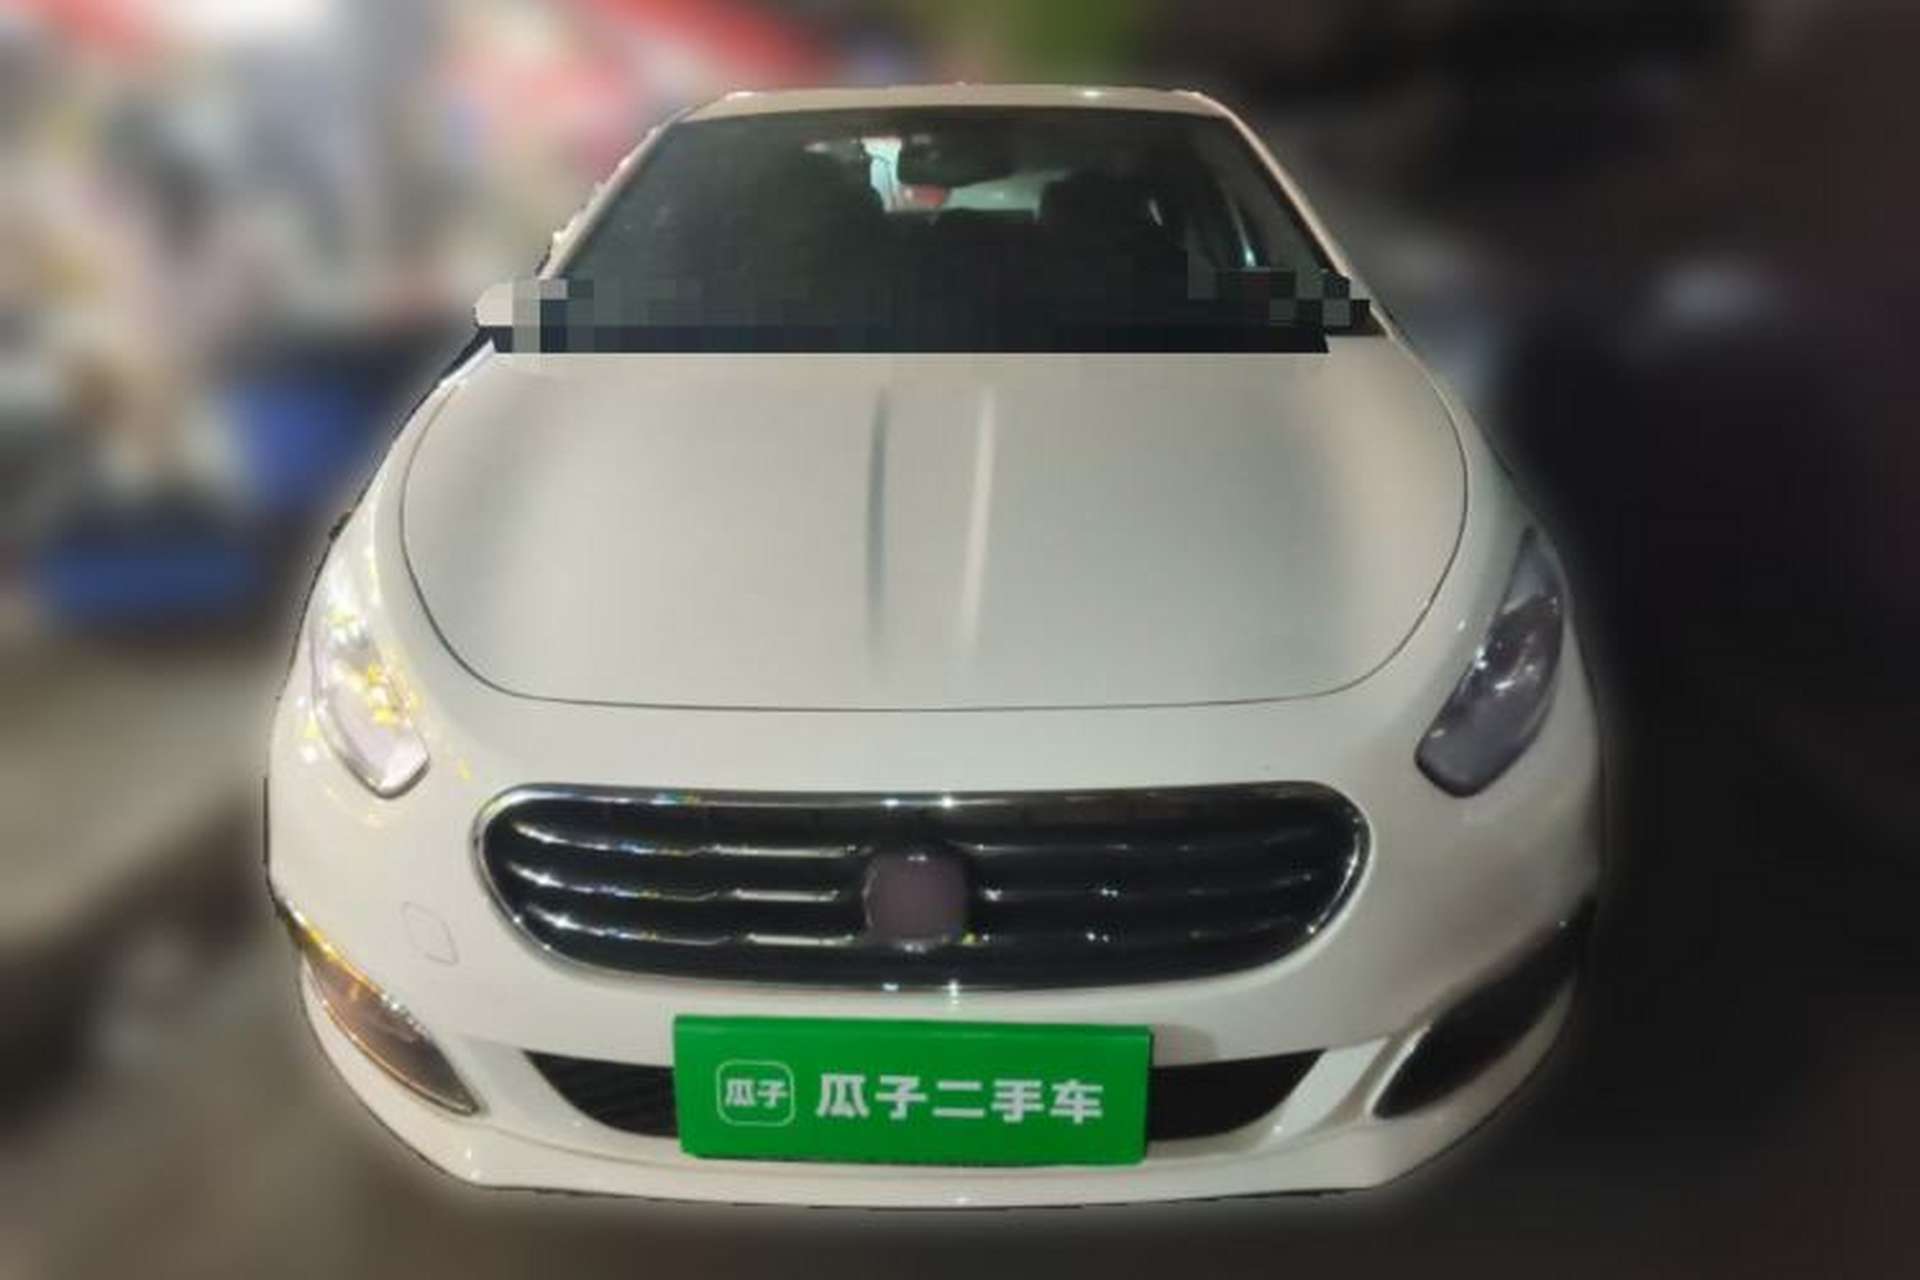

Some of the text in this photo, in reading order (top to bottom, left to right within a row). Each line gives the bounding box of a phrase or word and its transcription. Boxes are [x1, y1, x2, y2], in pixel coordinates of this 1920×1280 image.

[725, 1078, 788, 1108] 瓜子
[816, 1074, 1103, 1124] 瓜子二手车
